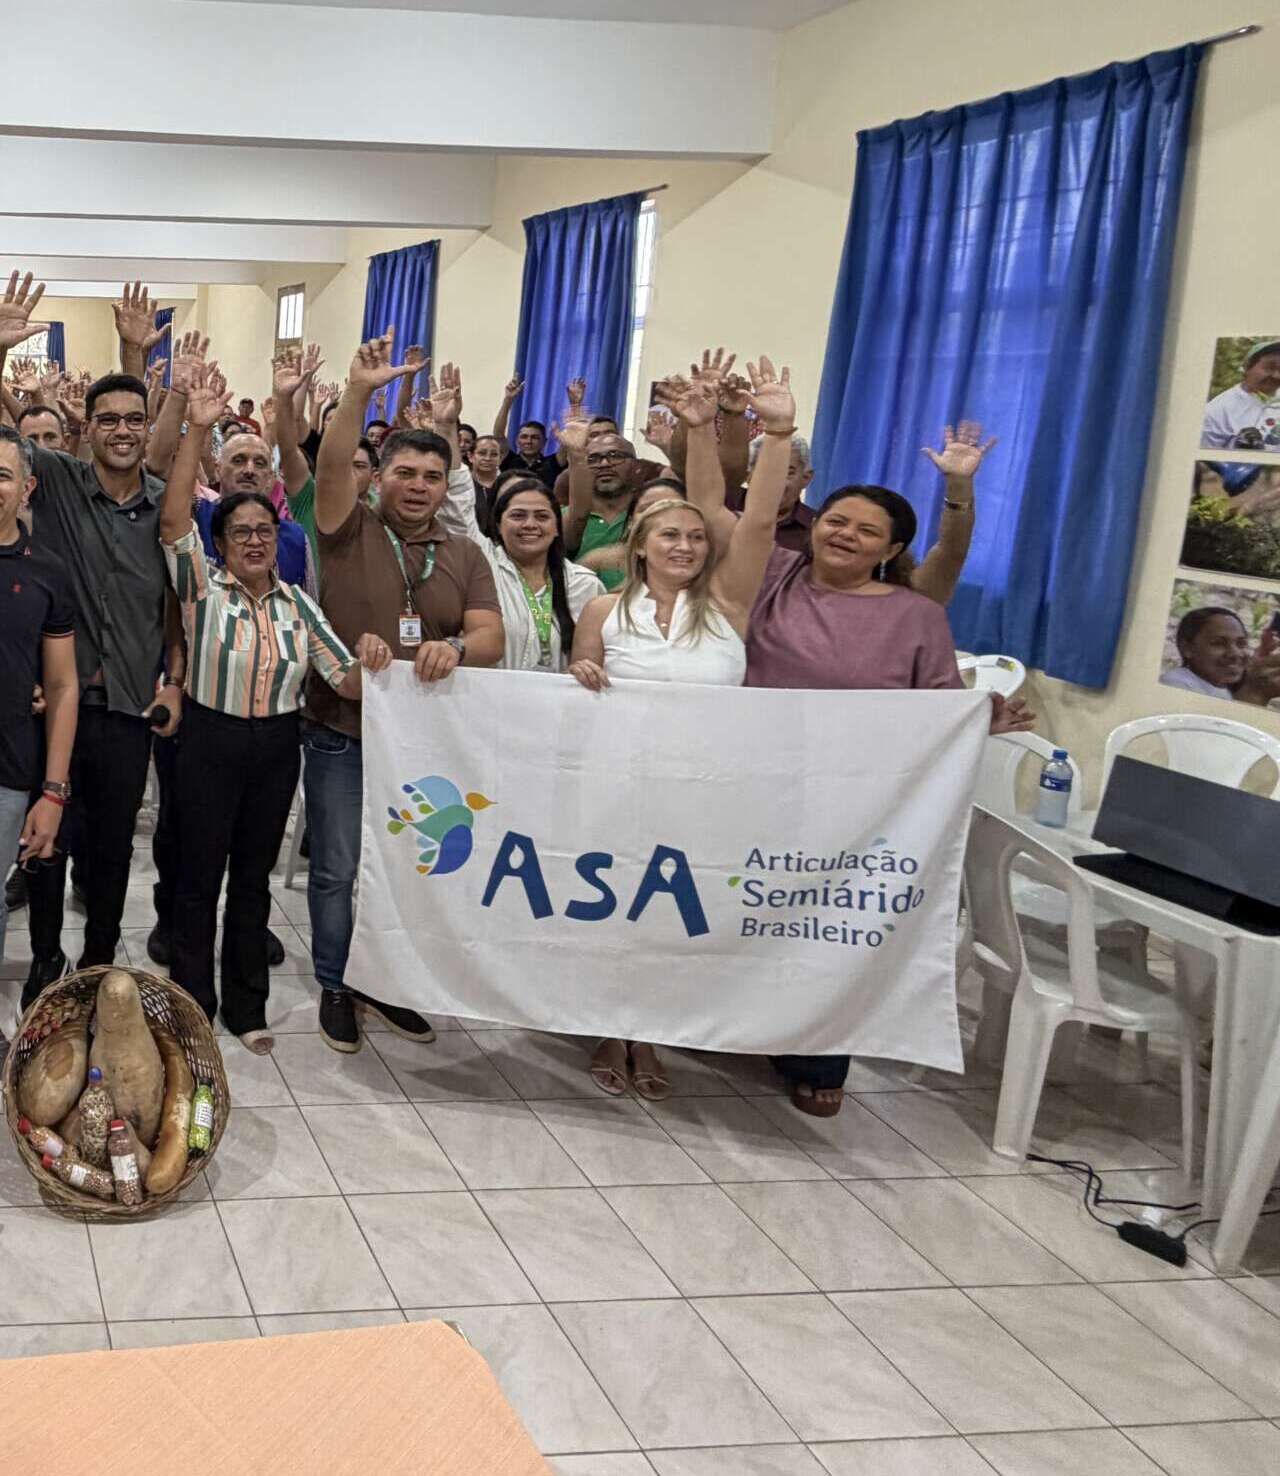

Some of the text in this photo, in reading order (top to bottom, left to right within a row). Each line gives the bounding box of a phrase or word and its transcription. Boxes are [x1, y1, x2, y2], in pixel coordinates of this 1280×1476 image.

[744, 847, 918, 877] Articulação
[481, 830, 710, 938] ASA
[741, 878, 925, 914] Semiárido
[739, 916, 883, 947] Brasileiro
